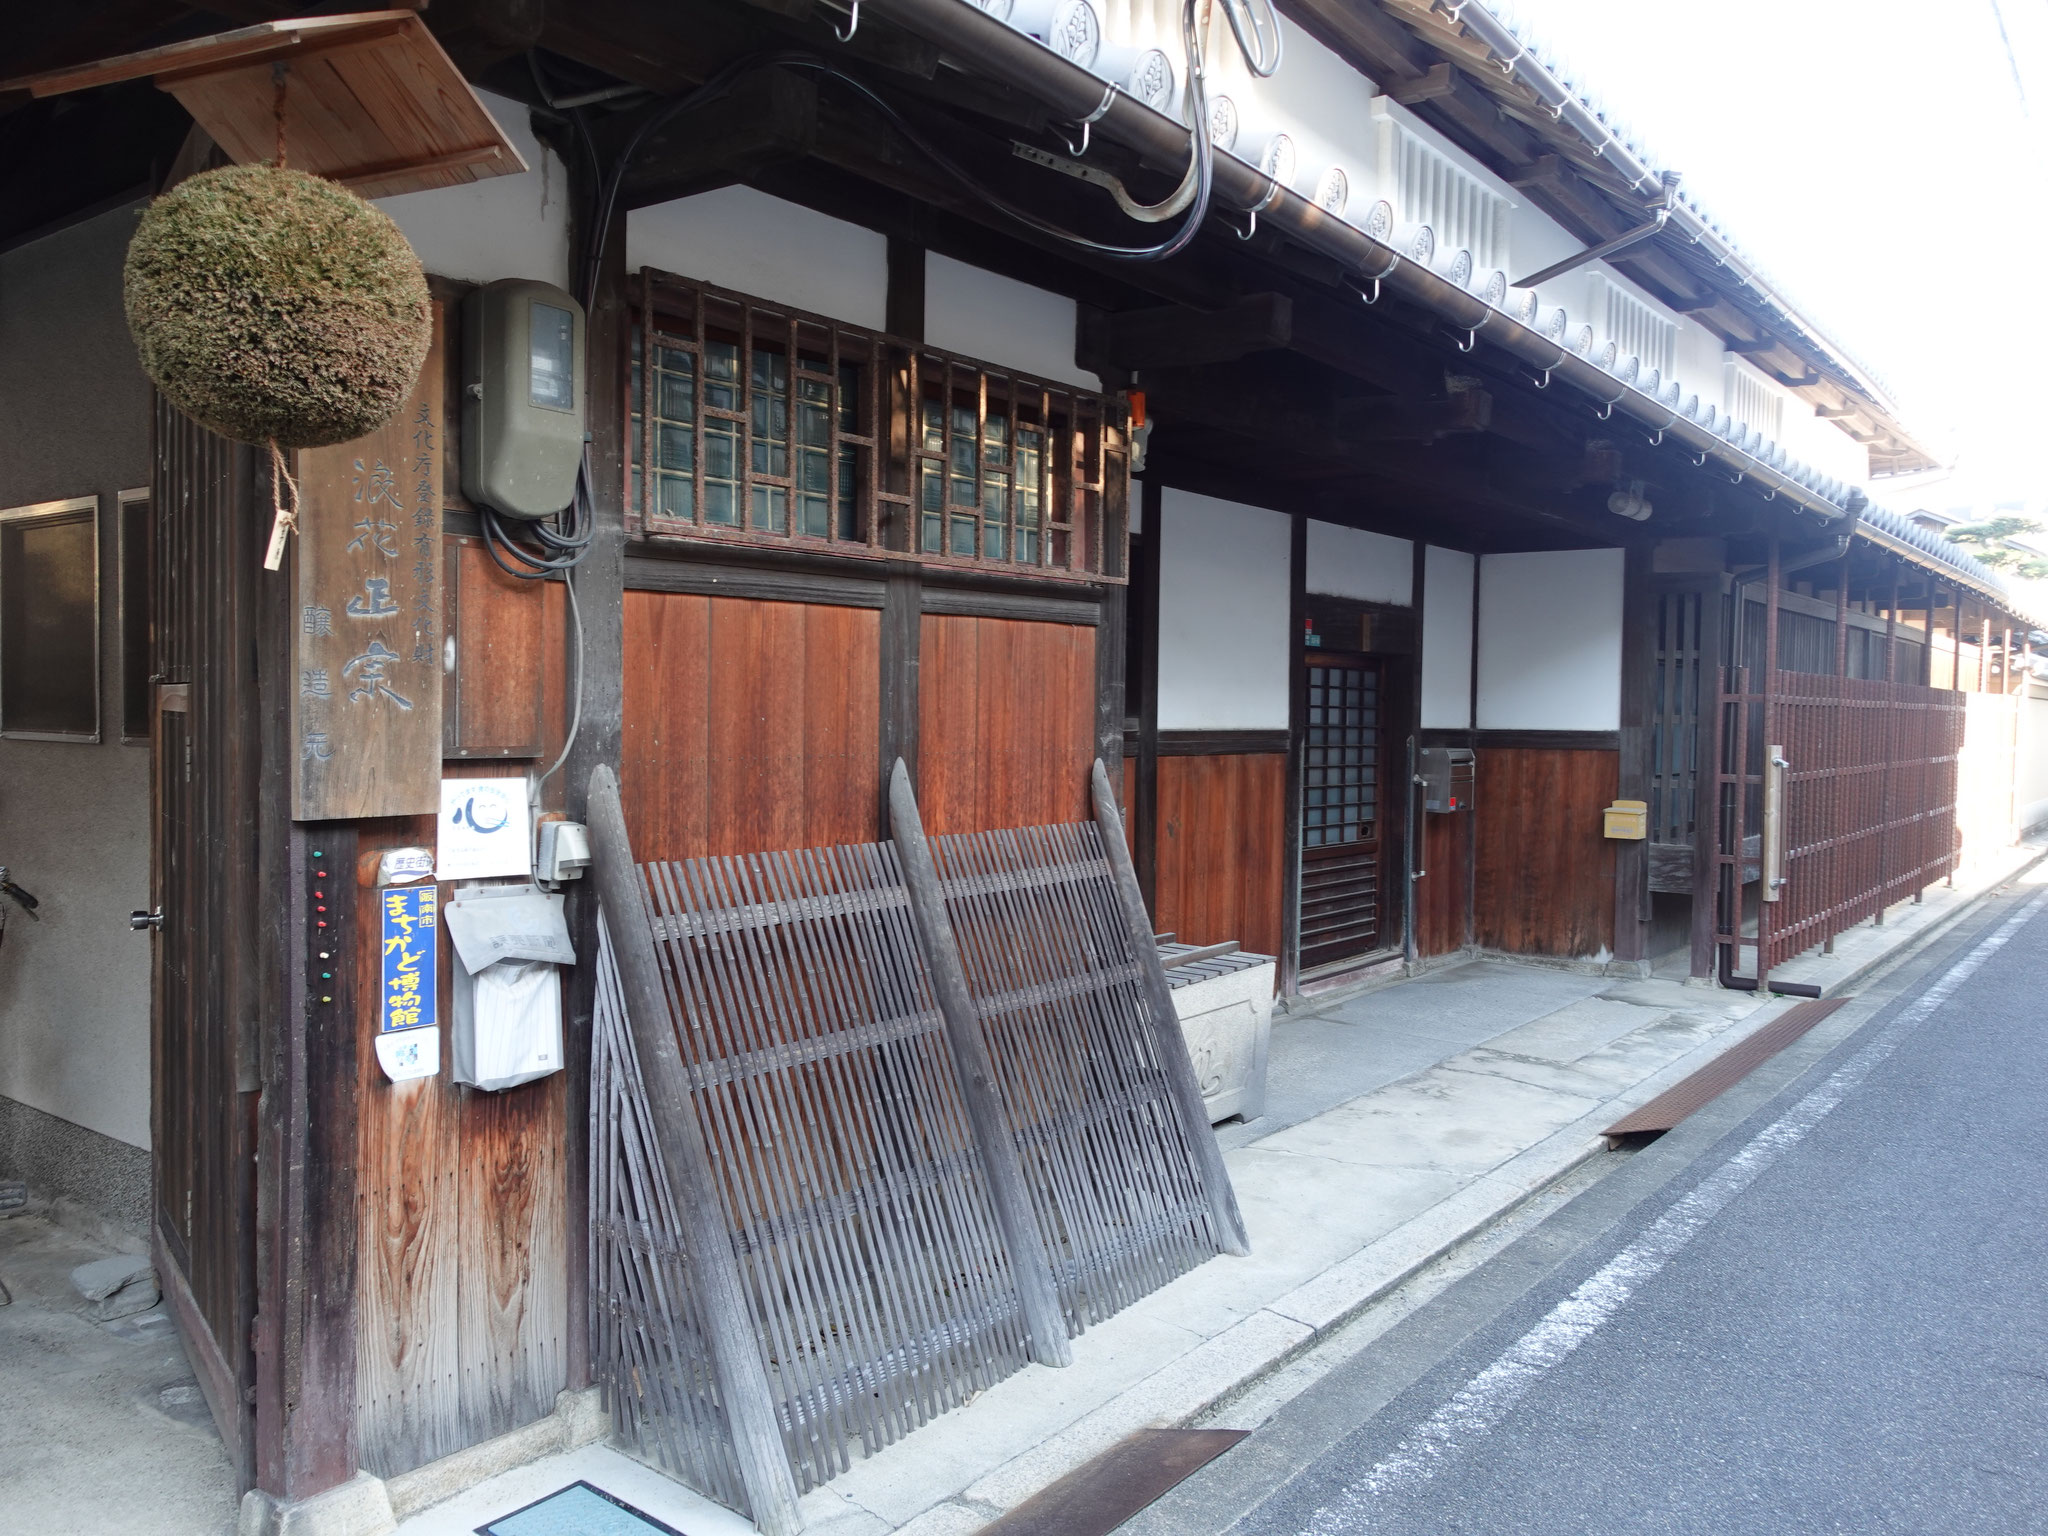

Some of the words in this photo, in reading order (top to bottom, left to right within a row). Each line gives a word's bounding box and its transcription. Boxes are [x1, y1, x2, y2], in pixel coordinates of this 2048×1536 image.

[343, 459, 414, 710] 浪花正宗
[411, 403, 436, 665] 文化庁登録有形文化財
[301, 605, 337, 762] 醸造元
[384, 894, 426, 1028] まちかど博物館
[420, 891, 434, 926] 阪南市
